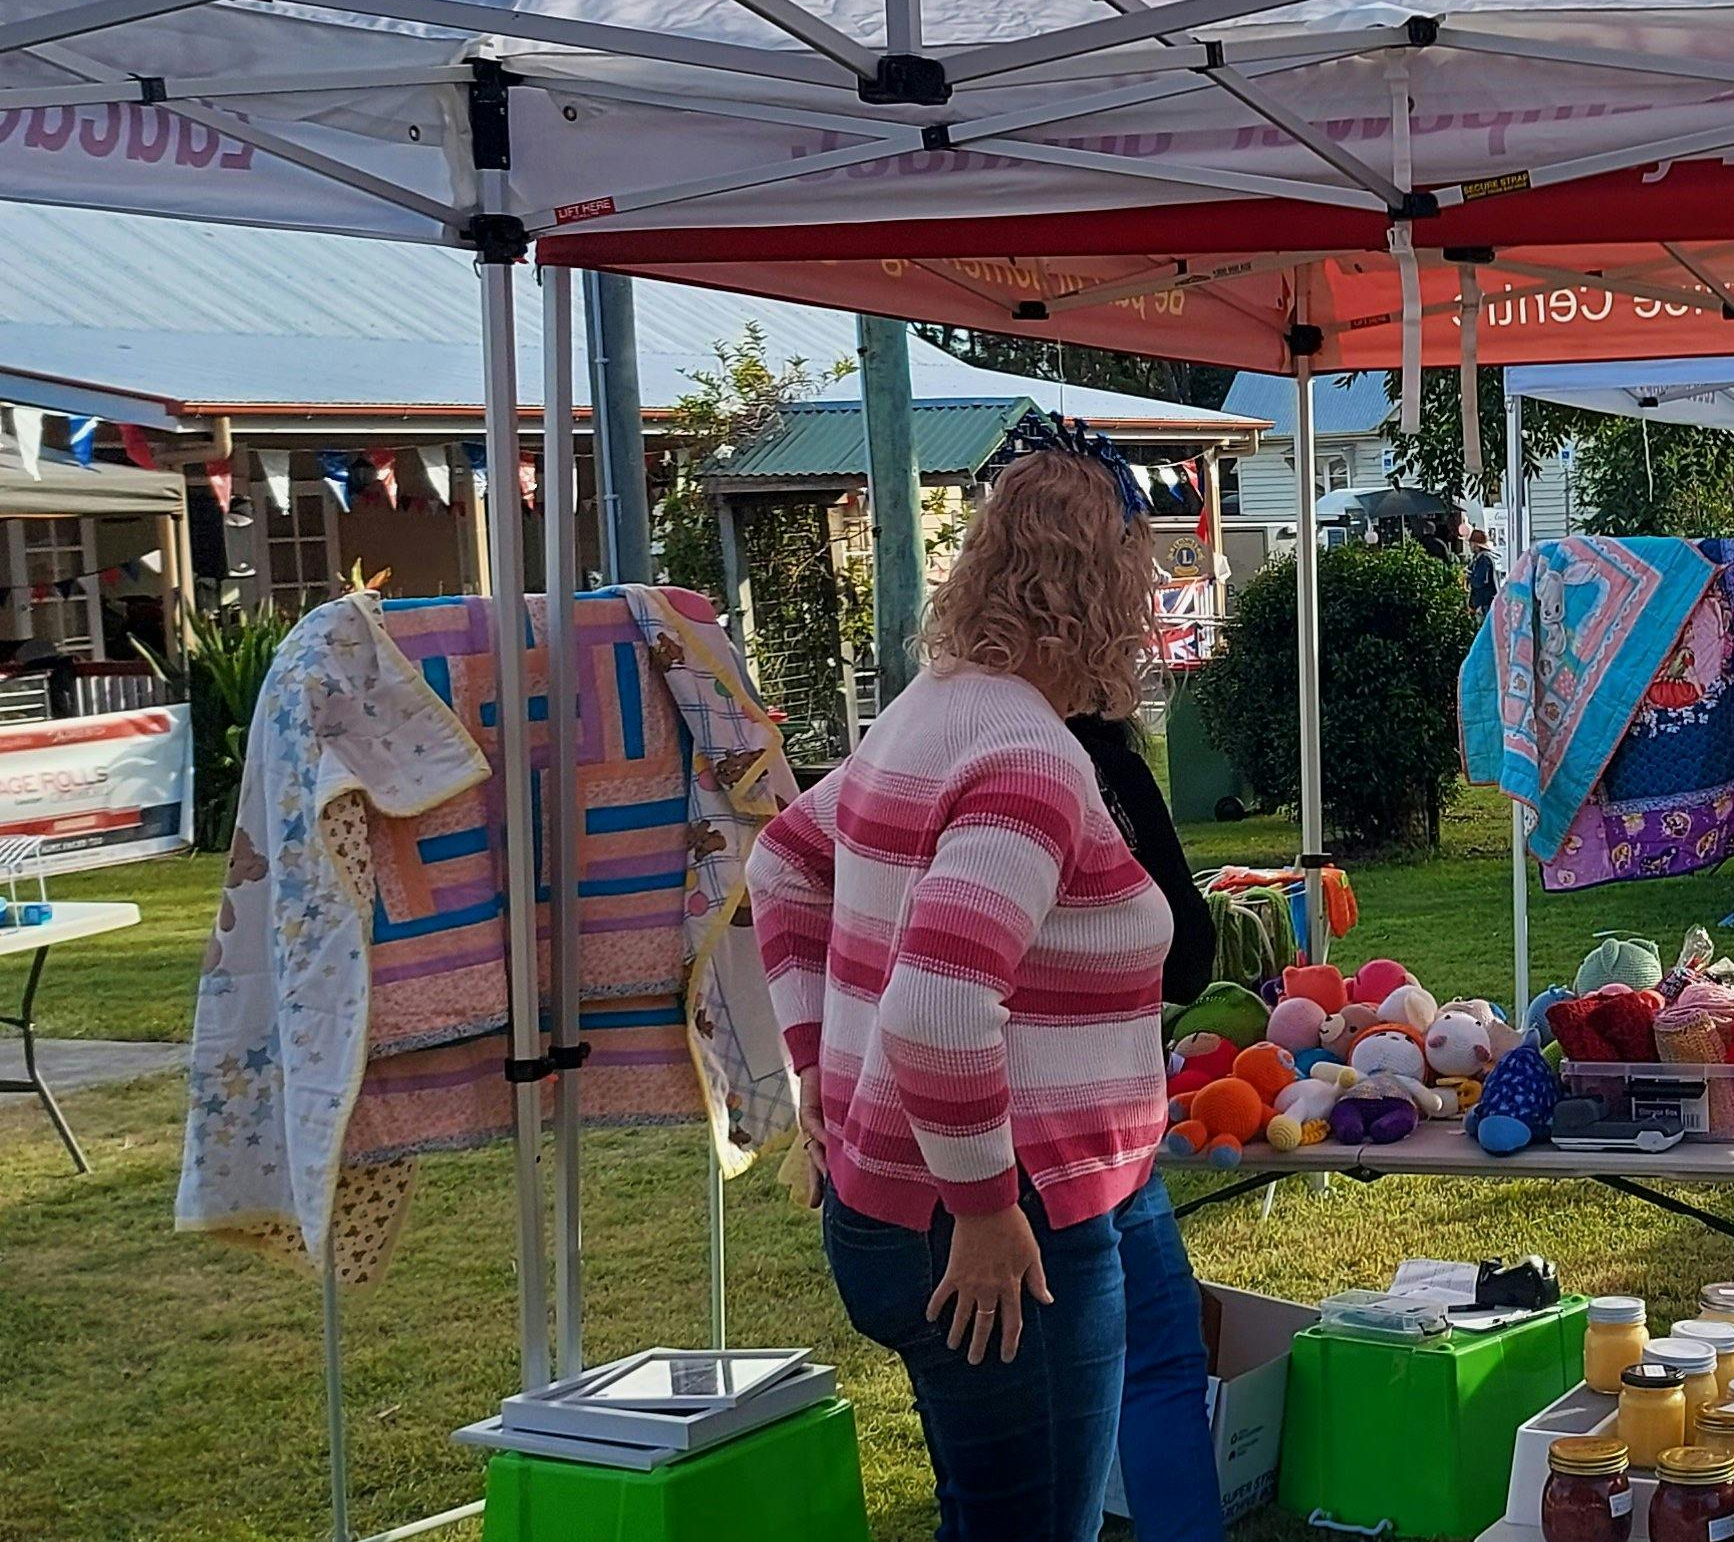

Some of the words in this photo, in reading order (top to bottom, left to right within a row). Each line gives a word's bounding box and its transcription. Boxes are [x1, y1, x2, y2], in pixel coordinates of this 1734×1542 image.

[558, 206, 580, 219] LIFT
[582, 199, 611, 213] HERE
[39, 766, 108, 792] ROLLS
